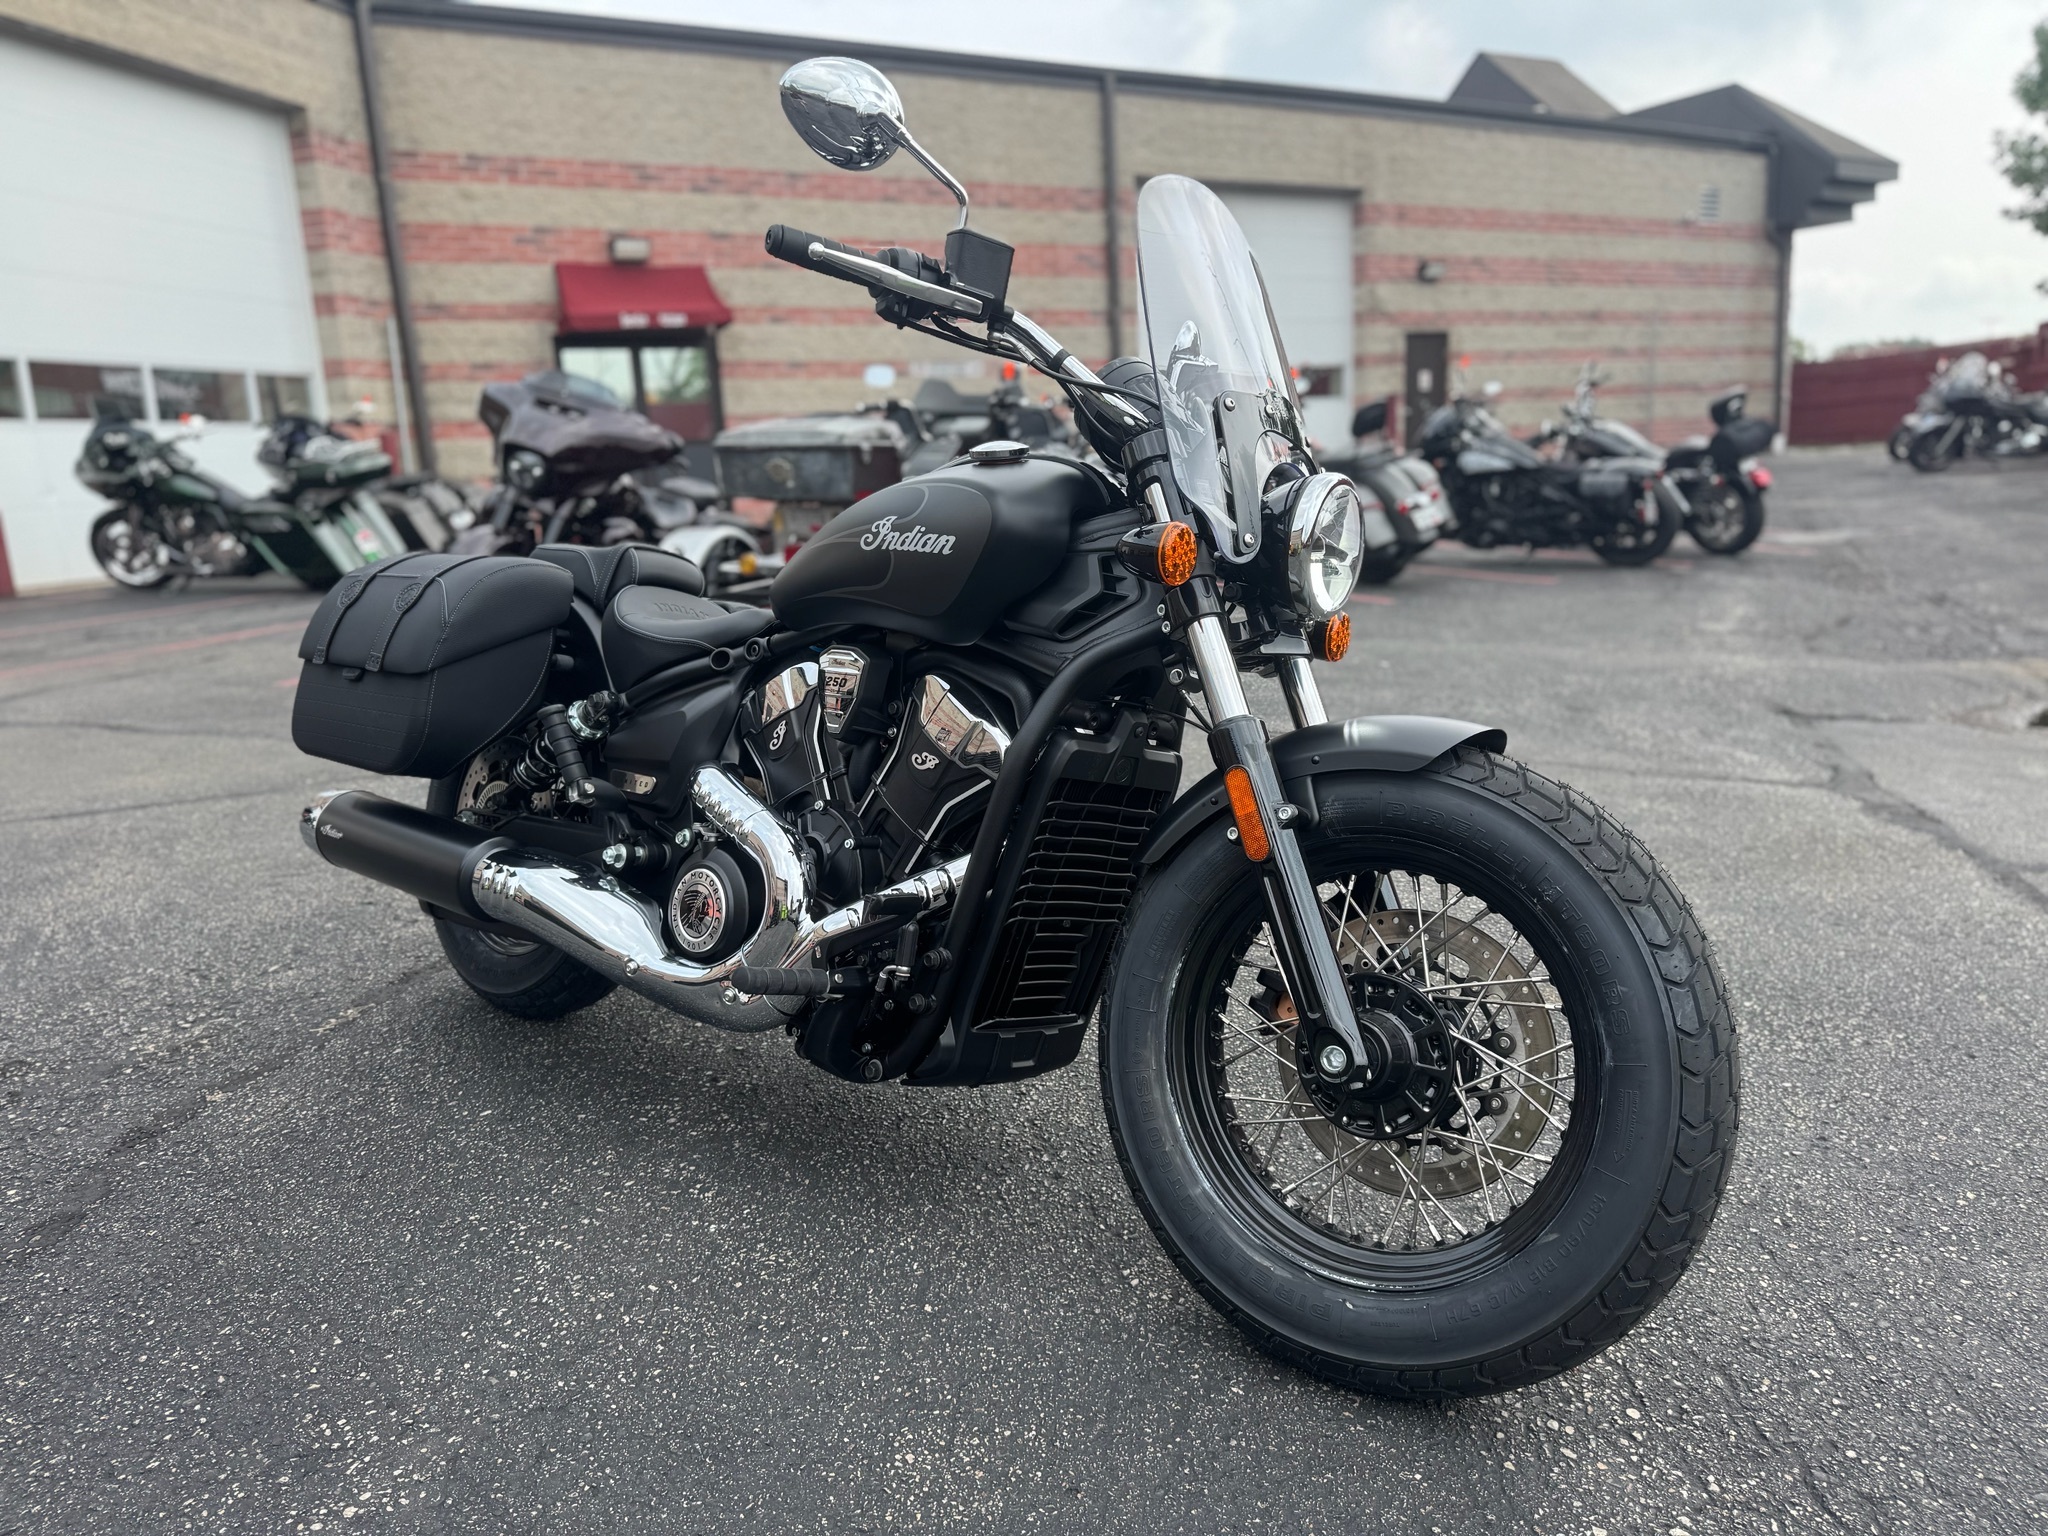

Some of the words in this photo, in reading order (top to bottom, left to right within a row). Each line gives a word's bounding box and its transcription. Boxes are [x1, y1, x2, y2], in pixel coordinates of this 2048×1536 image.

[860, 515, 957, 555] Indian
[825, 677, 848, 688] 250
[1385, 801, 1531, 874] PIRELLI
[672, 879, 688, 929] INDIAN
[690, 871, 722, 941] MOTORCYCLE
[682, 939, 701, 949] 1901
[1203, 1224, 1333, 1322] PIRELLI
